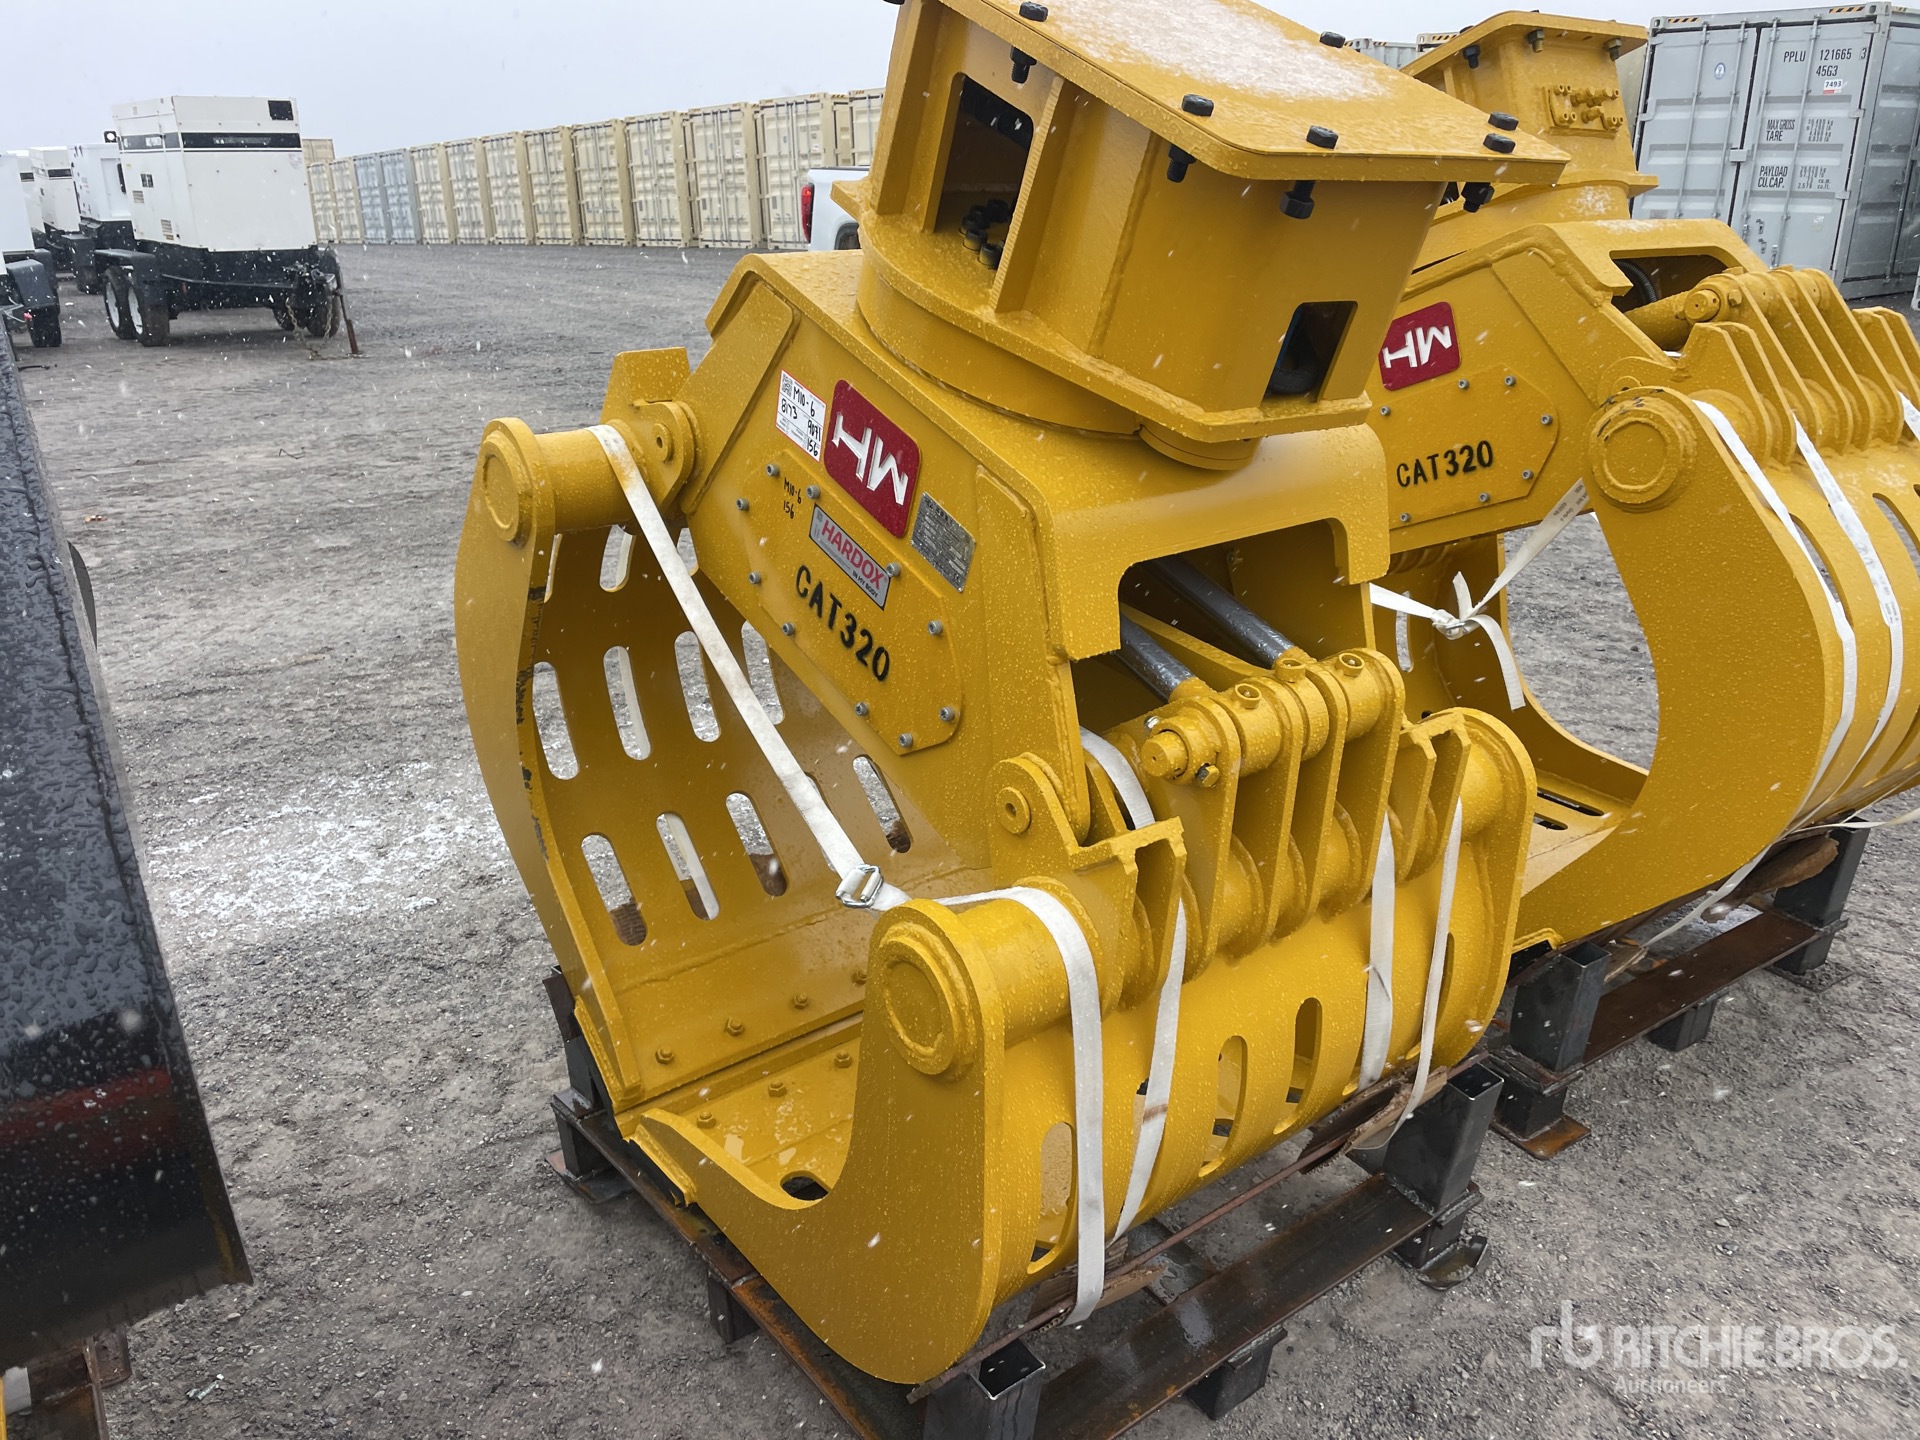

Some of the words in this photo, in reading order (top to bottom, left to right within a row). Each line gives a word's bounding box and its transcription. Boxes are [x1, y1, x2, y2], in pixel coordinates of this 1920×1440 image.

[1783, 50, 1806, 63] PPLU
[1820, 48, 1852, 61] 121665
[1860, 47, 1868, 60] 3
[1816, 65, 1838, 77] 45G3
[1766, 130, 1783, 141] TARE
[1760, 166, 1788, 177] PAYLOAD
[1396, 440, 1494, 488] CAT320
[821, 519, 885, 590] HARDOX
[795, 565, 891, 682] CAT320
